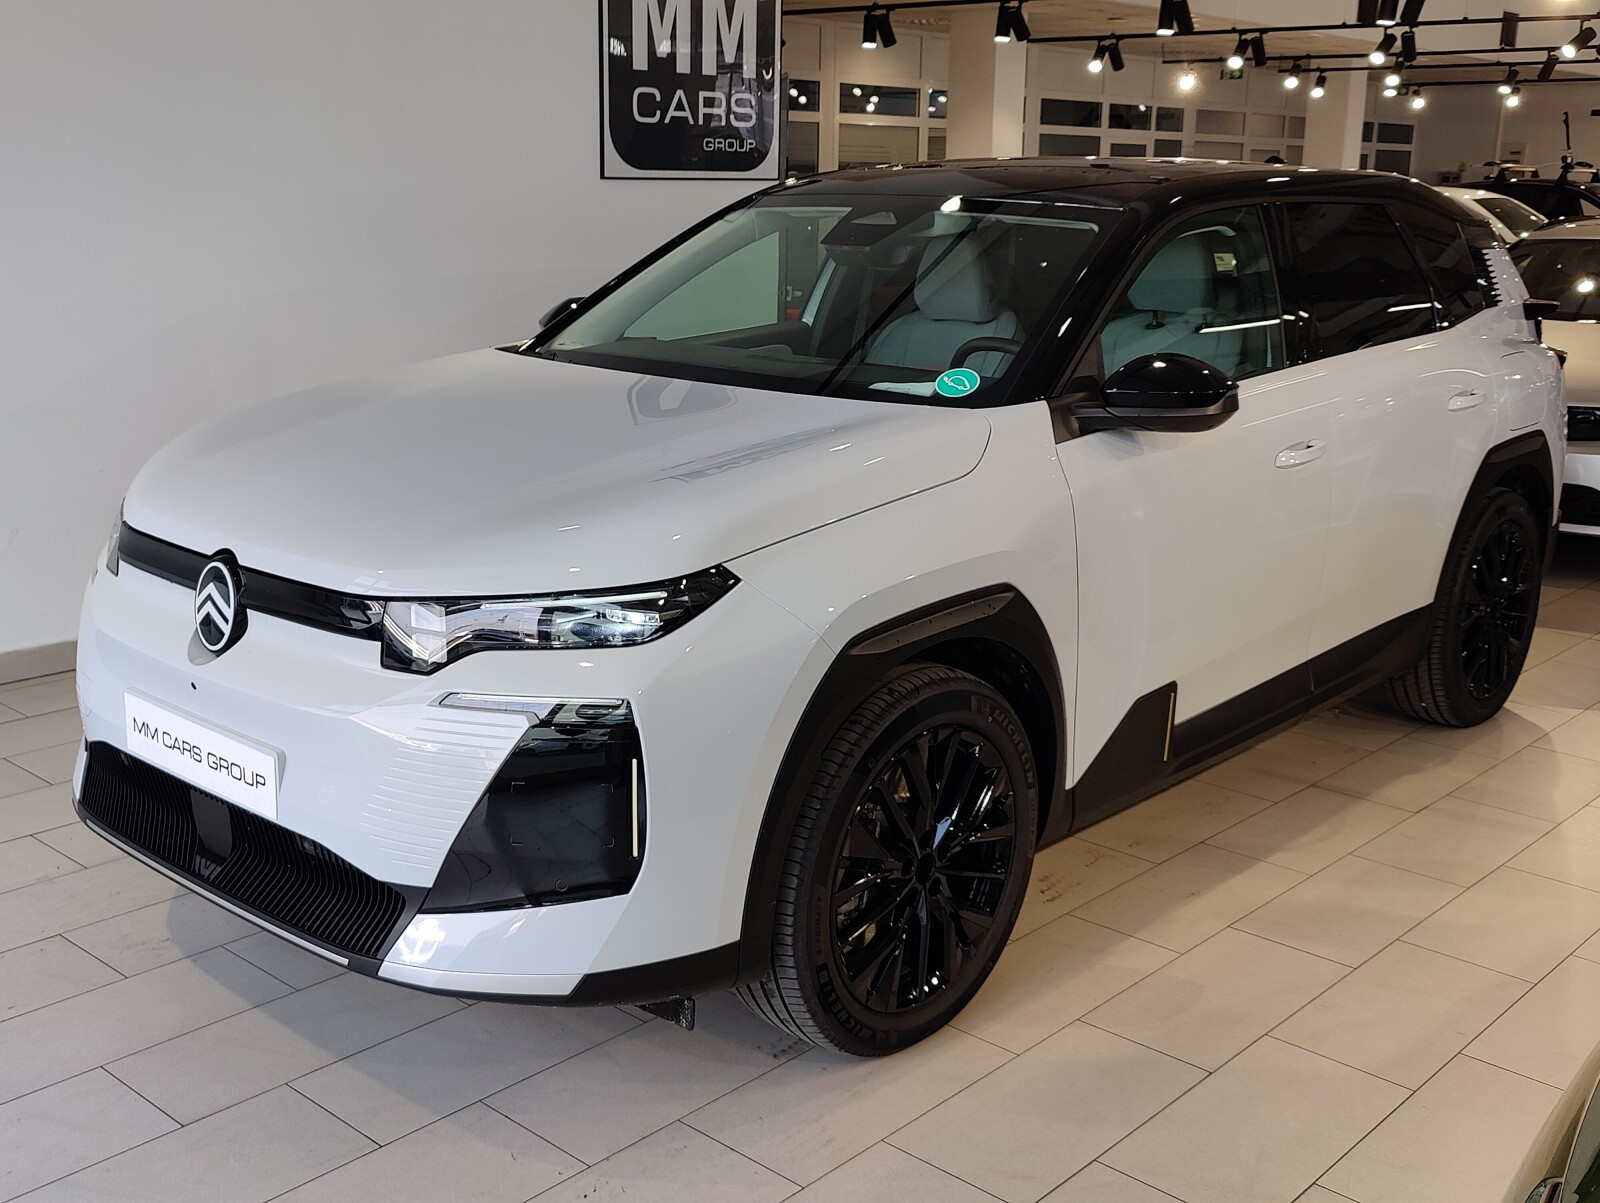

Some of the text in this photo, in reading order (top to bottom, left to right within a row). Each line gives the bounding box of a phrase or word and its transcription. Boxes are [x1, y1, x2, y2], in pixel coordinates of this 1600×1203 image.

[632, 0, 757, 79] MM
[632, 86, 757, 128] CARS
[703, 138, 756, 152] GROUP
[133, 717, 266, 789] MM CARS GROUP
[993, 708, 1034, 785] MICHELIN
